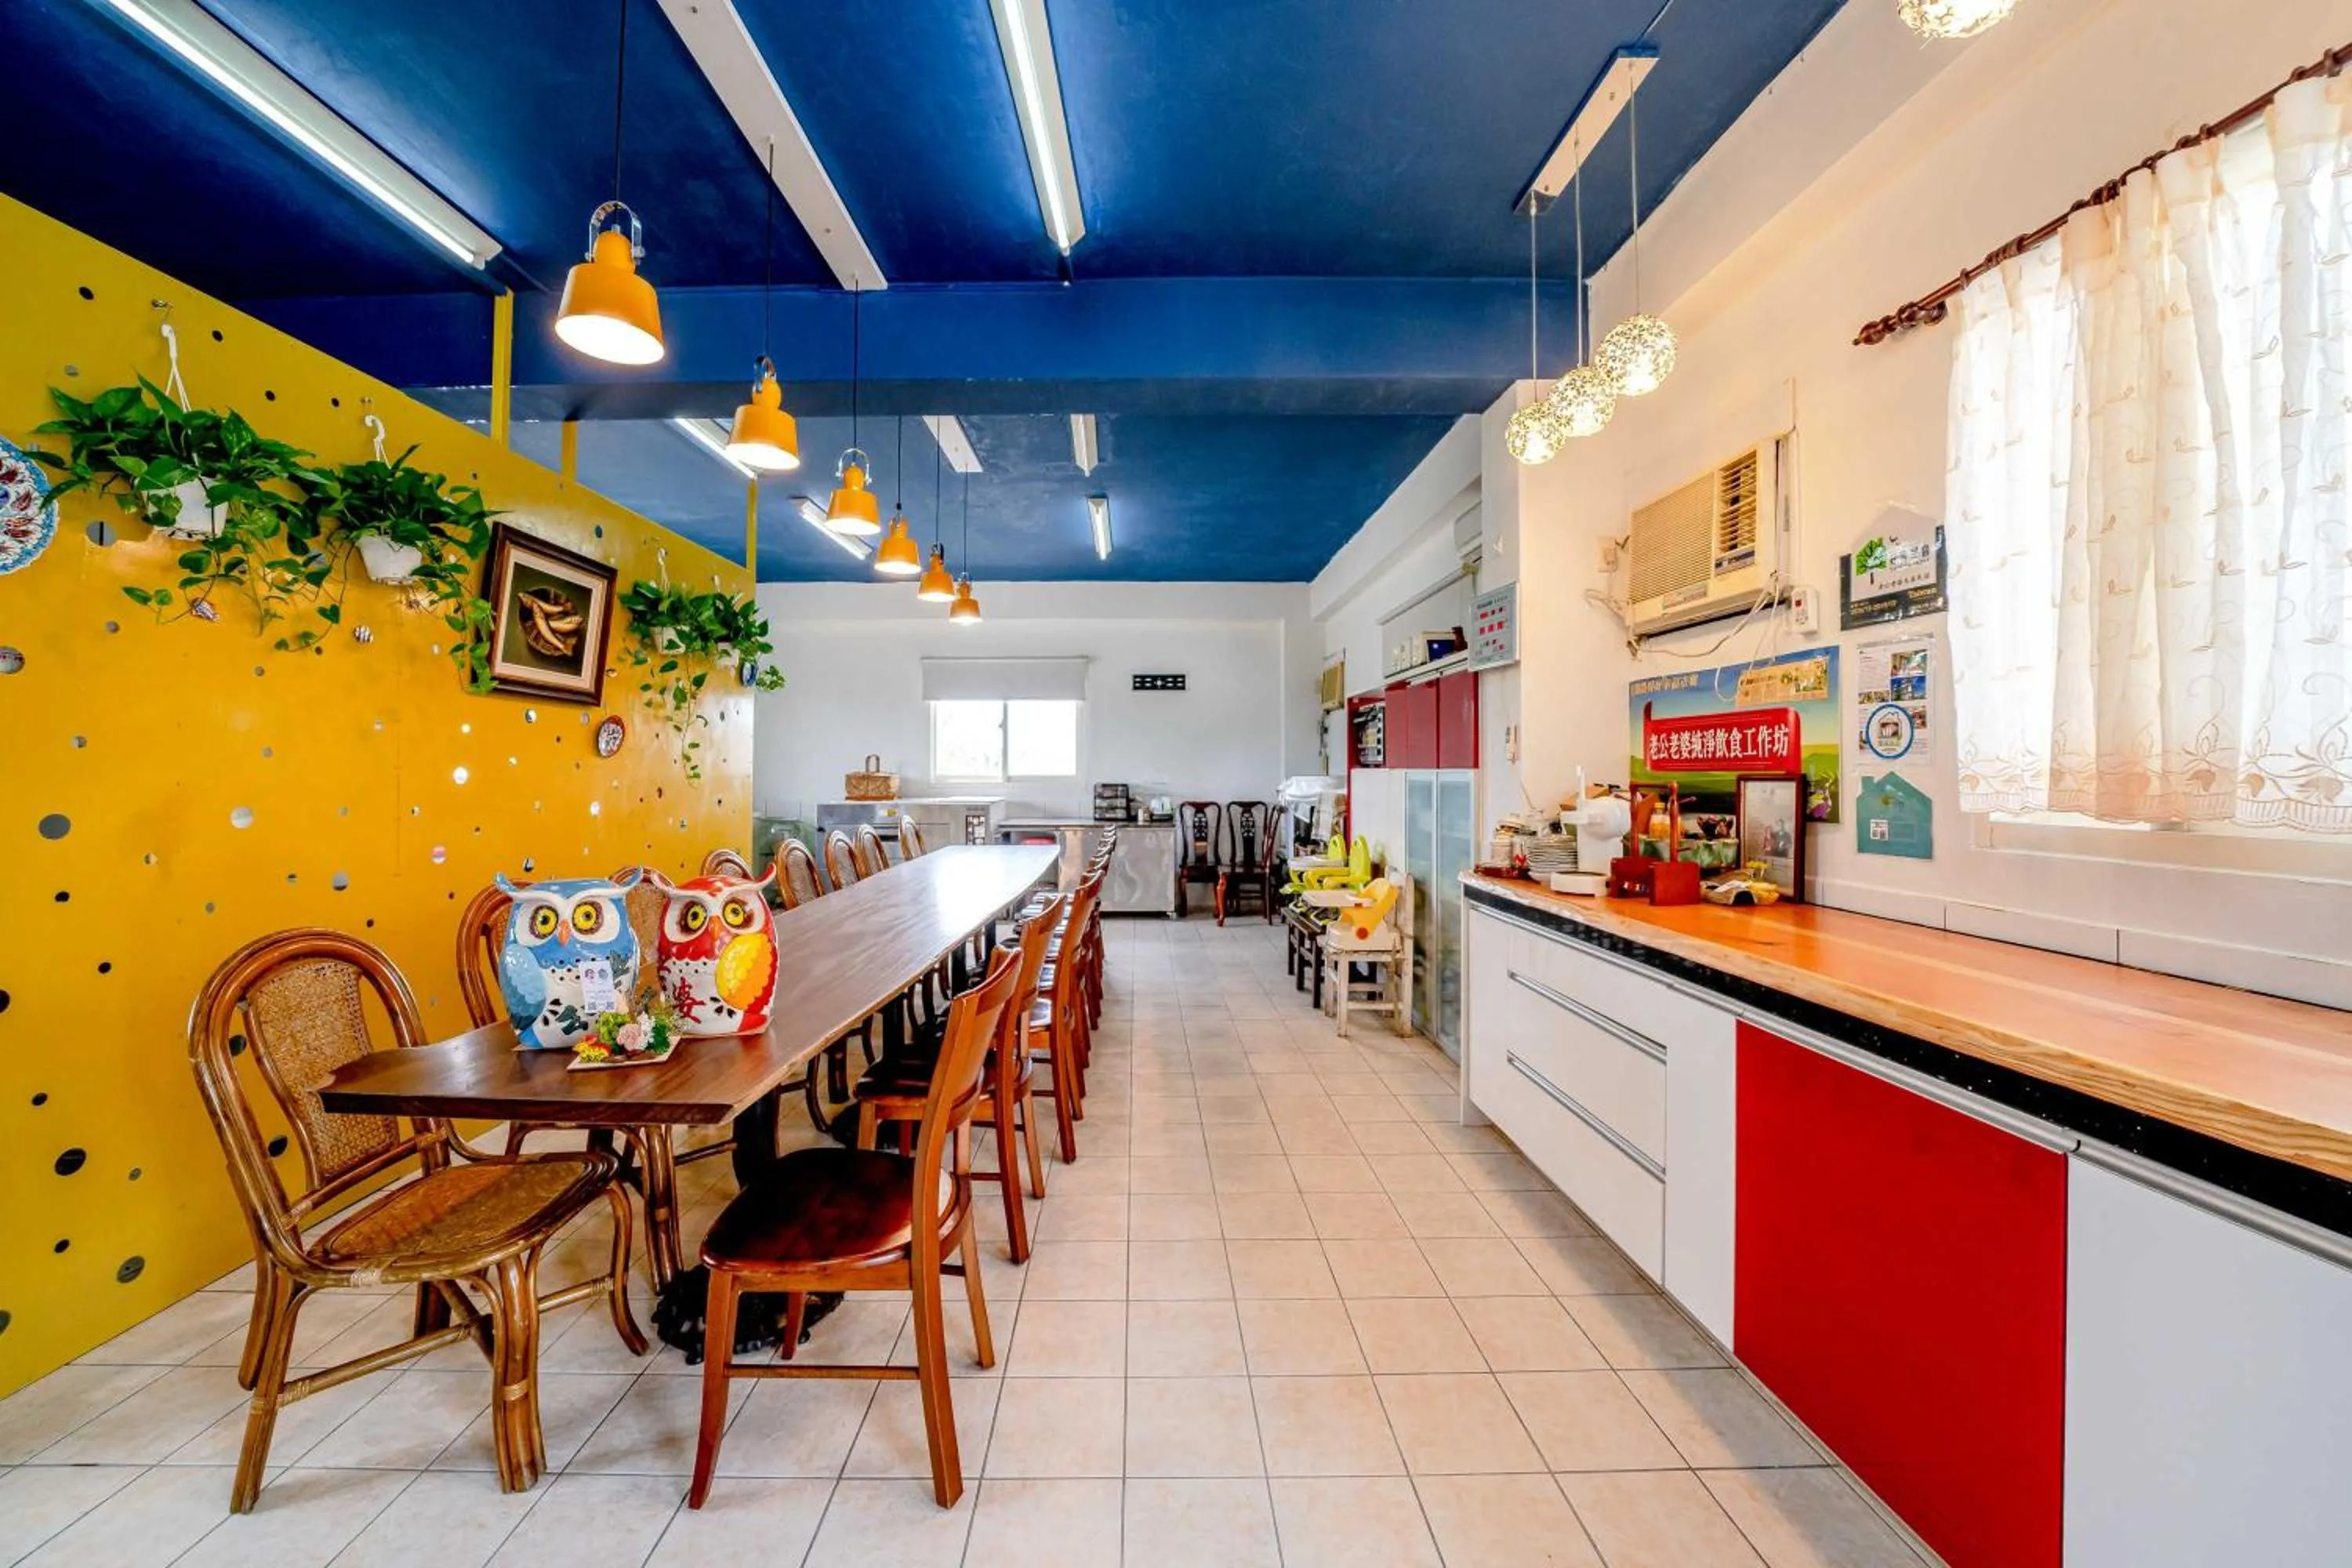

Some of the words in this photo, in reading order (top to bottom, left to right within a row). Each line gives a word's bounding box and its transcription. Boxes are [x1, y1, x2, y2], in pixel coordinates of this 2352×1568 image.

[1649, 724, 1790, 760] 老公老婆純淨飲食工作坊
